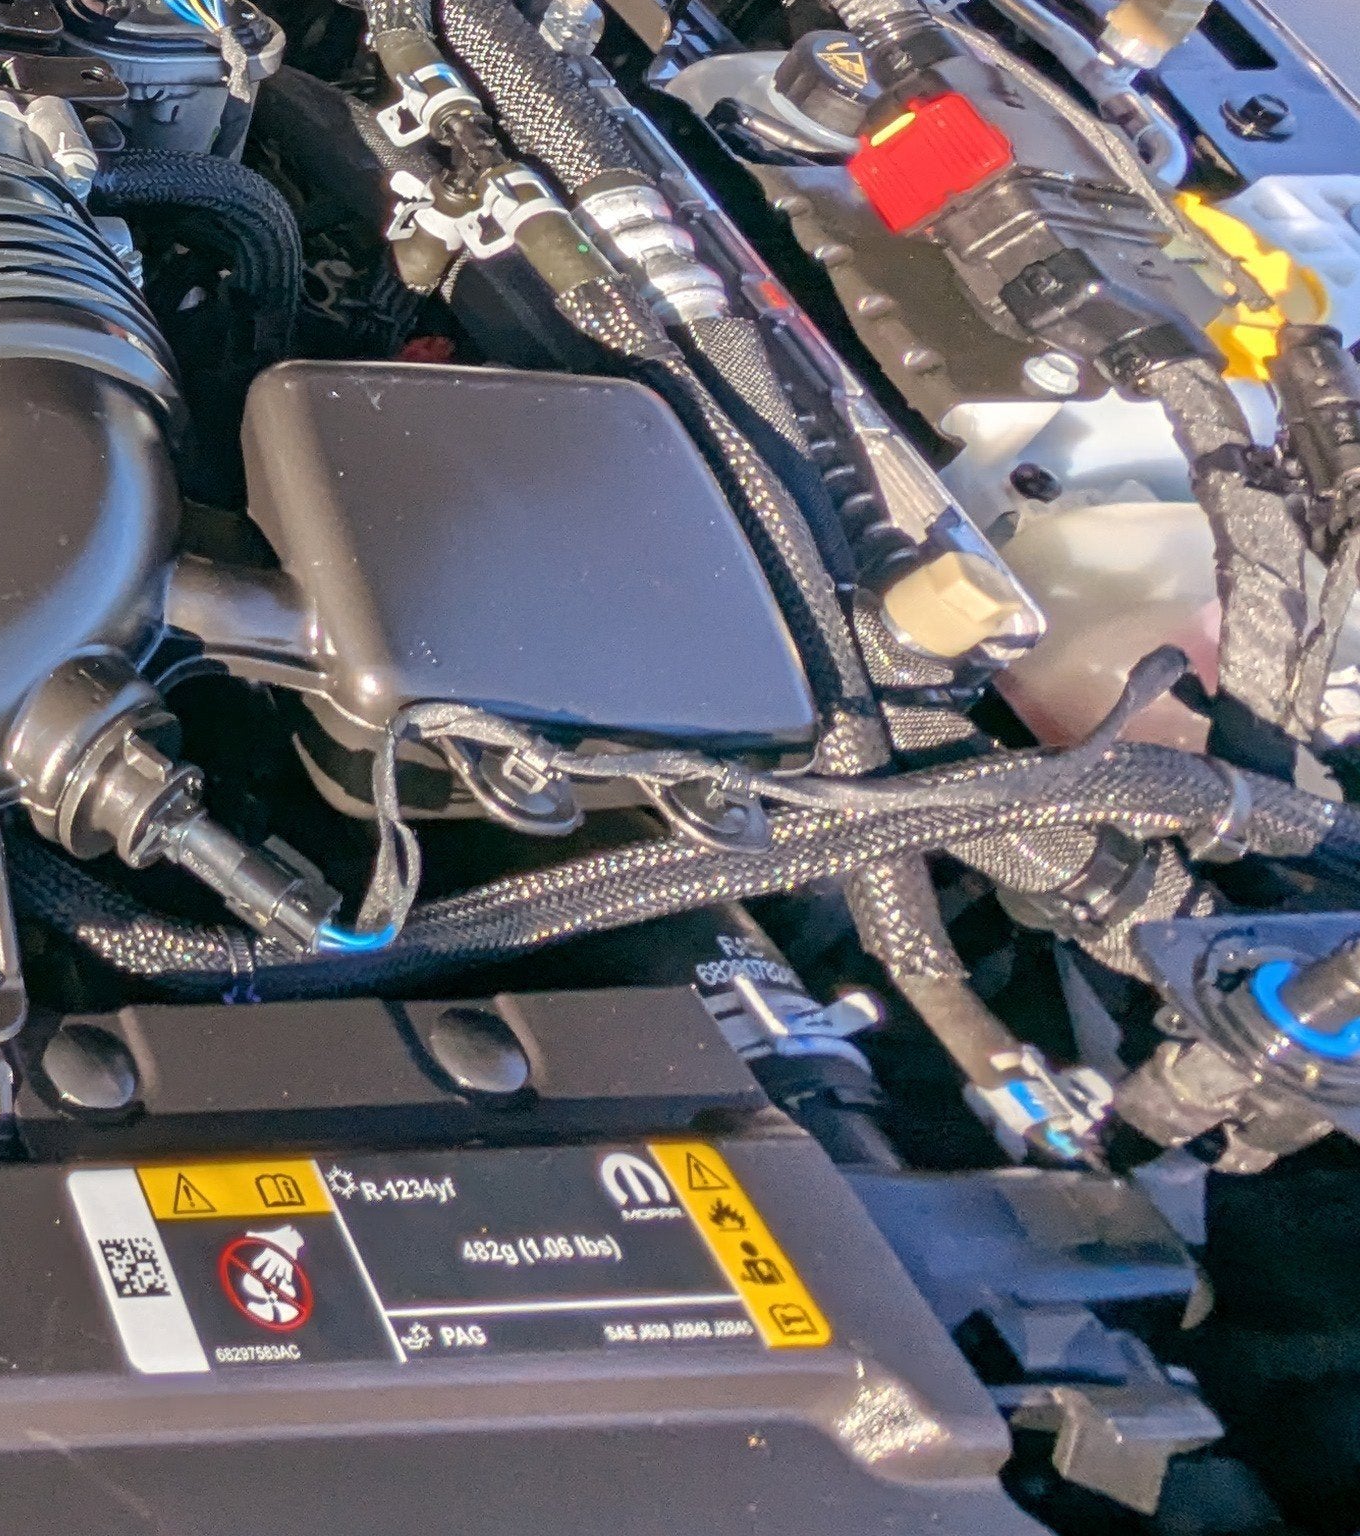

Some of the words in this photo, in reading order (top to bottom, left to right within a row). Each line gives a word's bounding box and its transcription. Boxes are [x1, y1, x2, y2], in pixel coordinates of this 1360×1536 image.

[360, 1177, 458, 1204] R-1234yf
[462, 1240, 519, 1266] 482g
[518, 1237, 575, 1264] (1.06
[574, 1234, 623, 1262] lbs)
[440, 1325, 487, 1346] PAG
